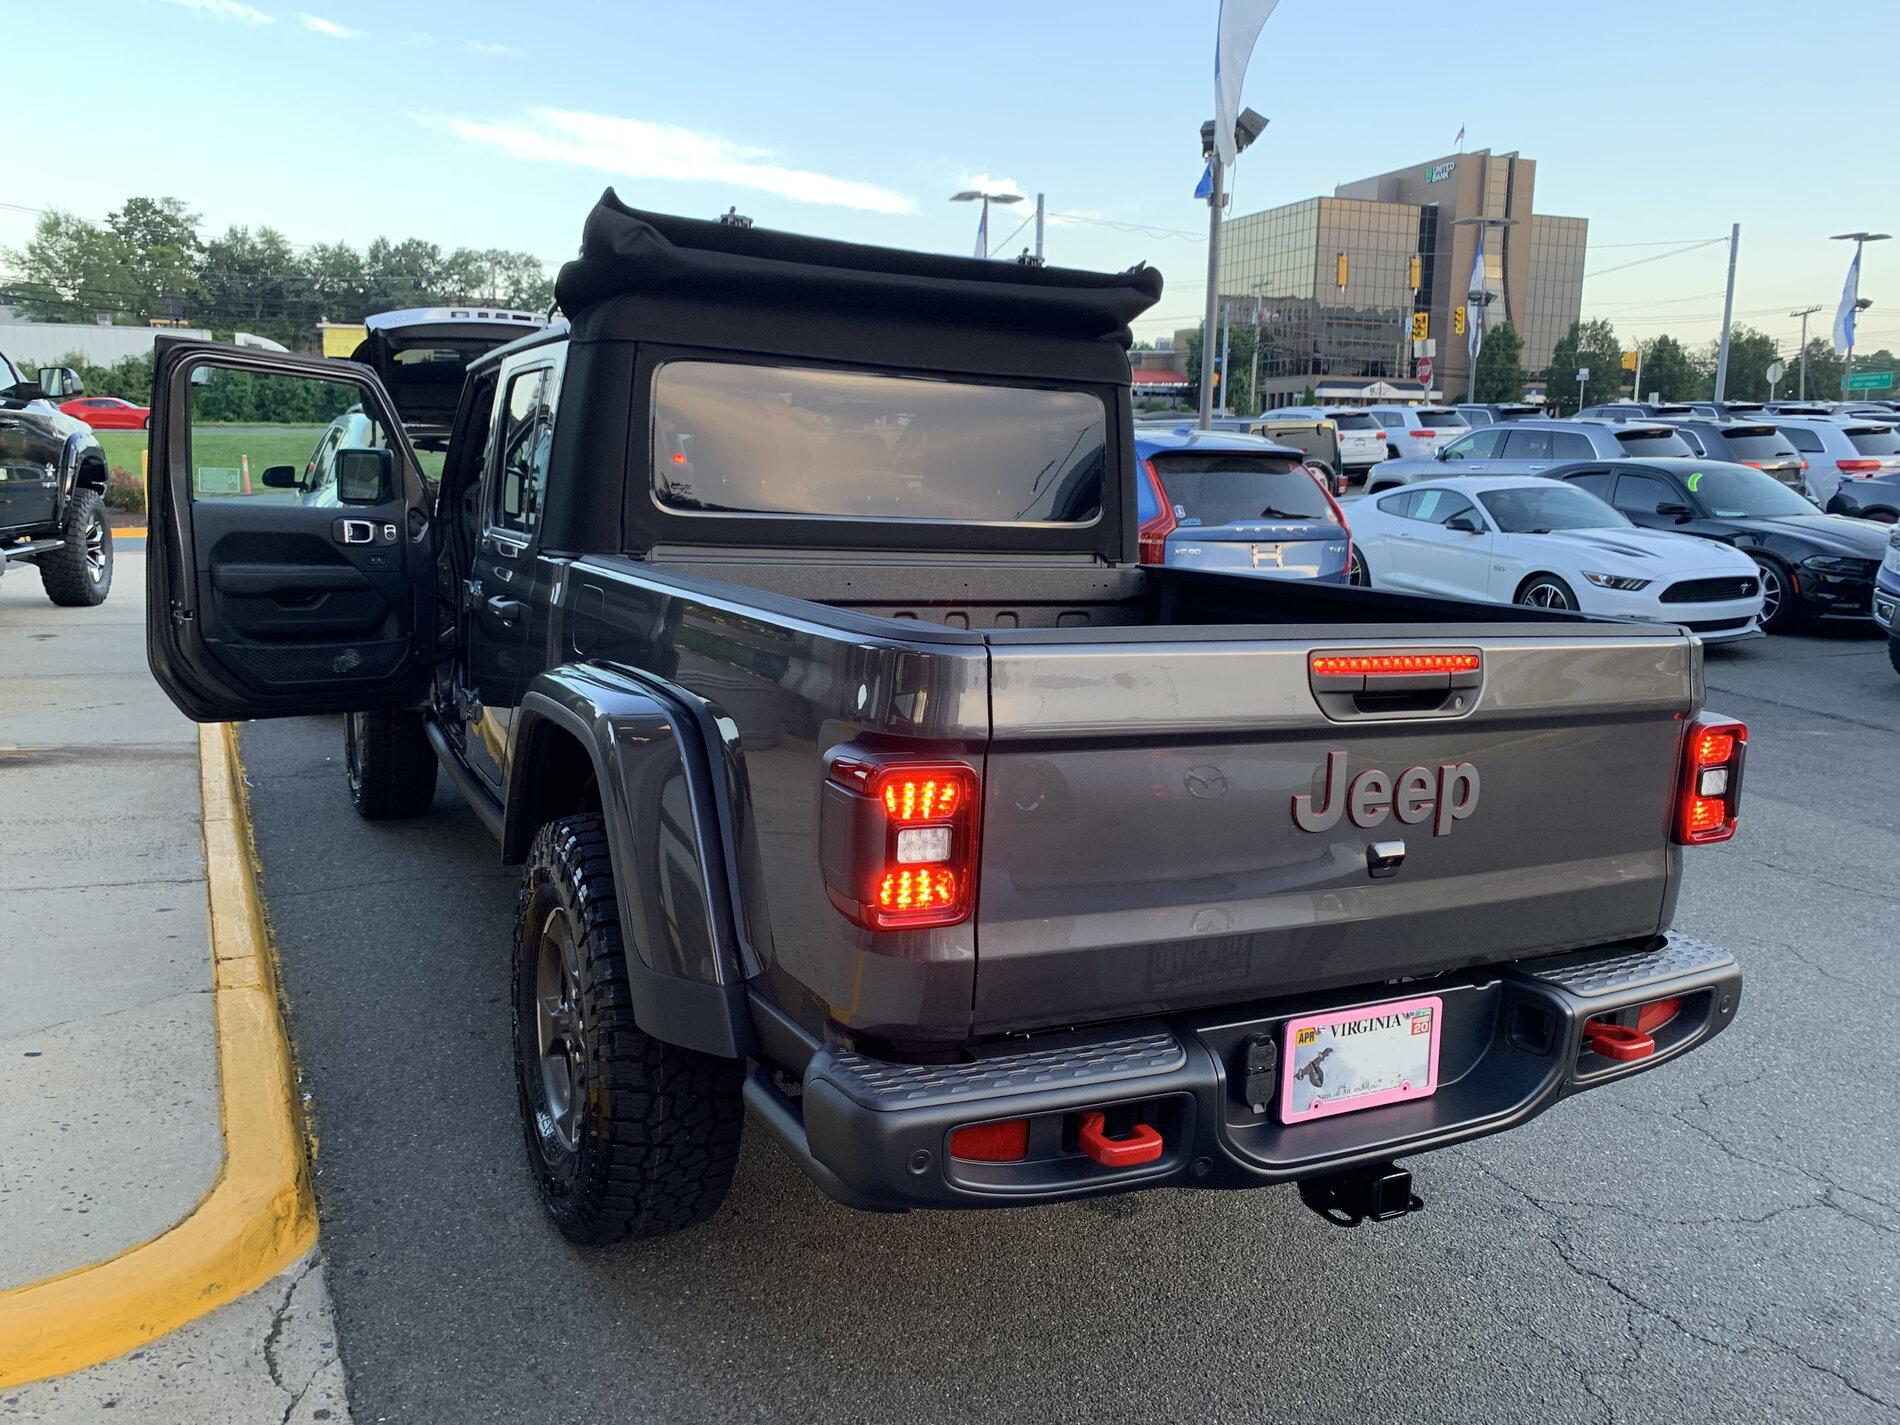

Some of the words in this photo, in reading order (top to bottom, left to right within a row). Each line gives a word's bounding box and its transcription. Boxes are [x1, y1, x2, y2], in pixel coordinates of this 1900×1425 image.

[1432, 162, 1455, 173] UNITED
[1432, 170, 1450, 183] BANK
[1418, 364, 1431, 377] STOP
[1292, 751, 1480, 836] Jeep
[1331, 1014, 1402, 1038] VIRGINIA
[1413, 1021, 1429, 1034] 20
[1298, 1031, 1315, 1044] APR
